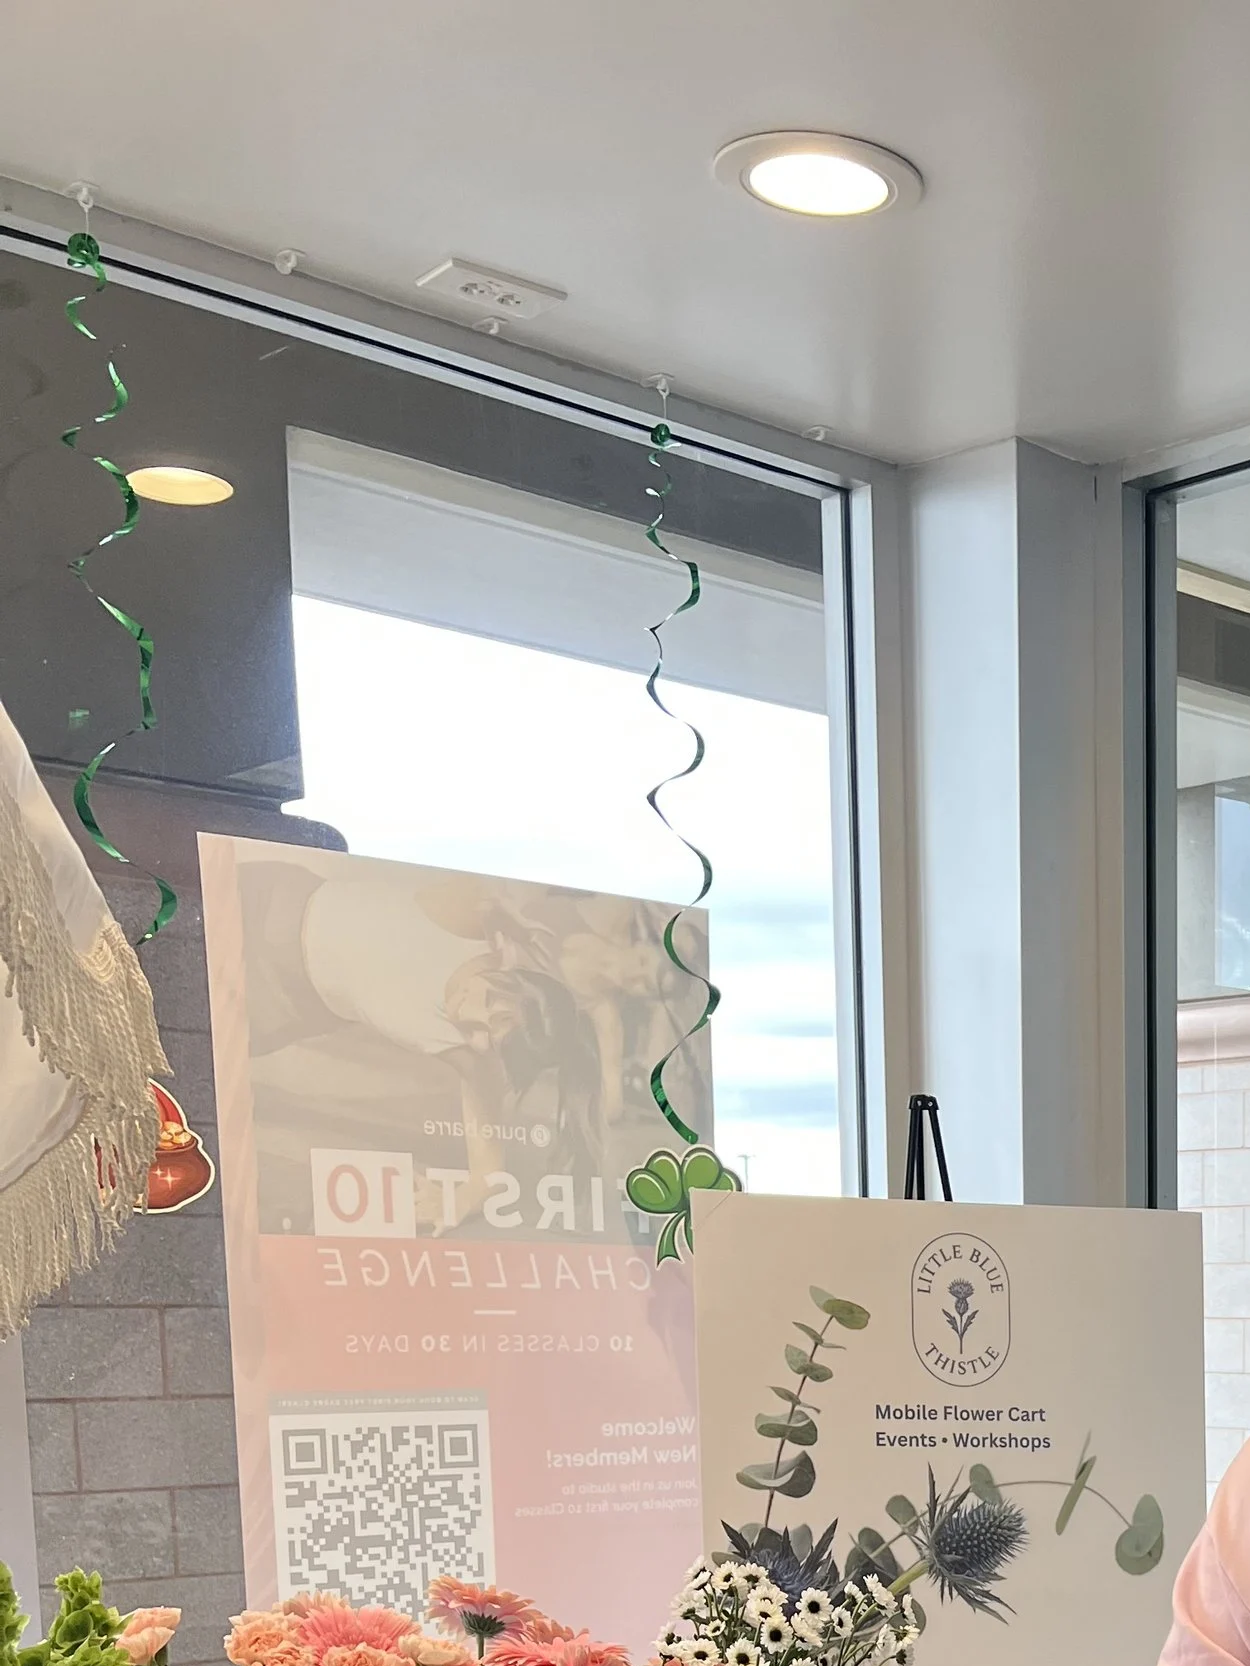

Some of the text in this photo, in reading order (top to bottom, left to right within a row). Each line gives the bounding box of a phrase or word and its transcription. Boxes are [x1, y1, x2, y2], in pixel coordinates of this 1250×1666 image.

[917, 1244, 1004, 1294] LITTLE BLUE
[924, 1342, 1000, 1375] THISTLE
[875, 1403, 1047, 1422] Mobile Flower Cart
[875, 1430, 1051, 1453] Events Workshops
